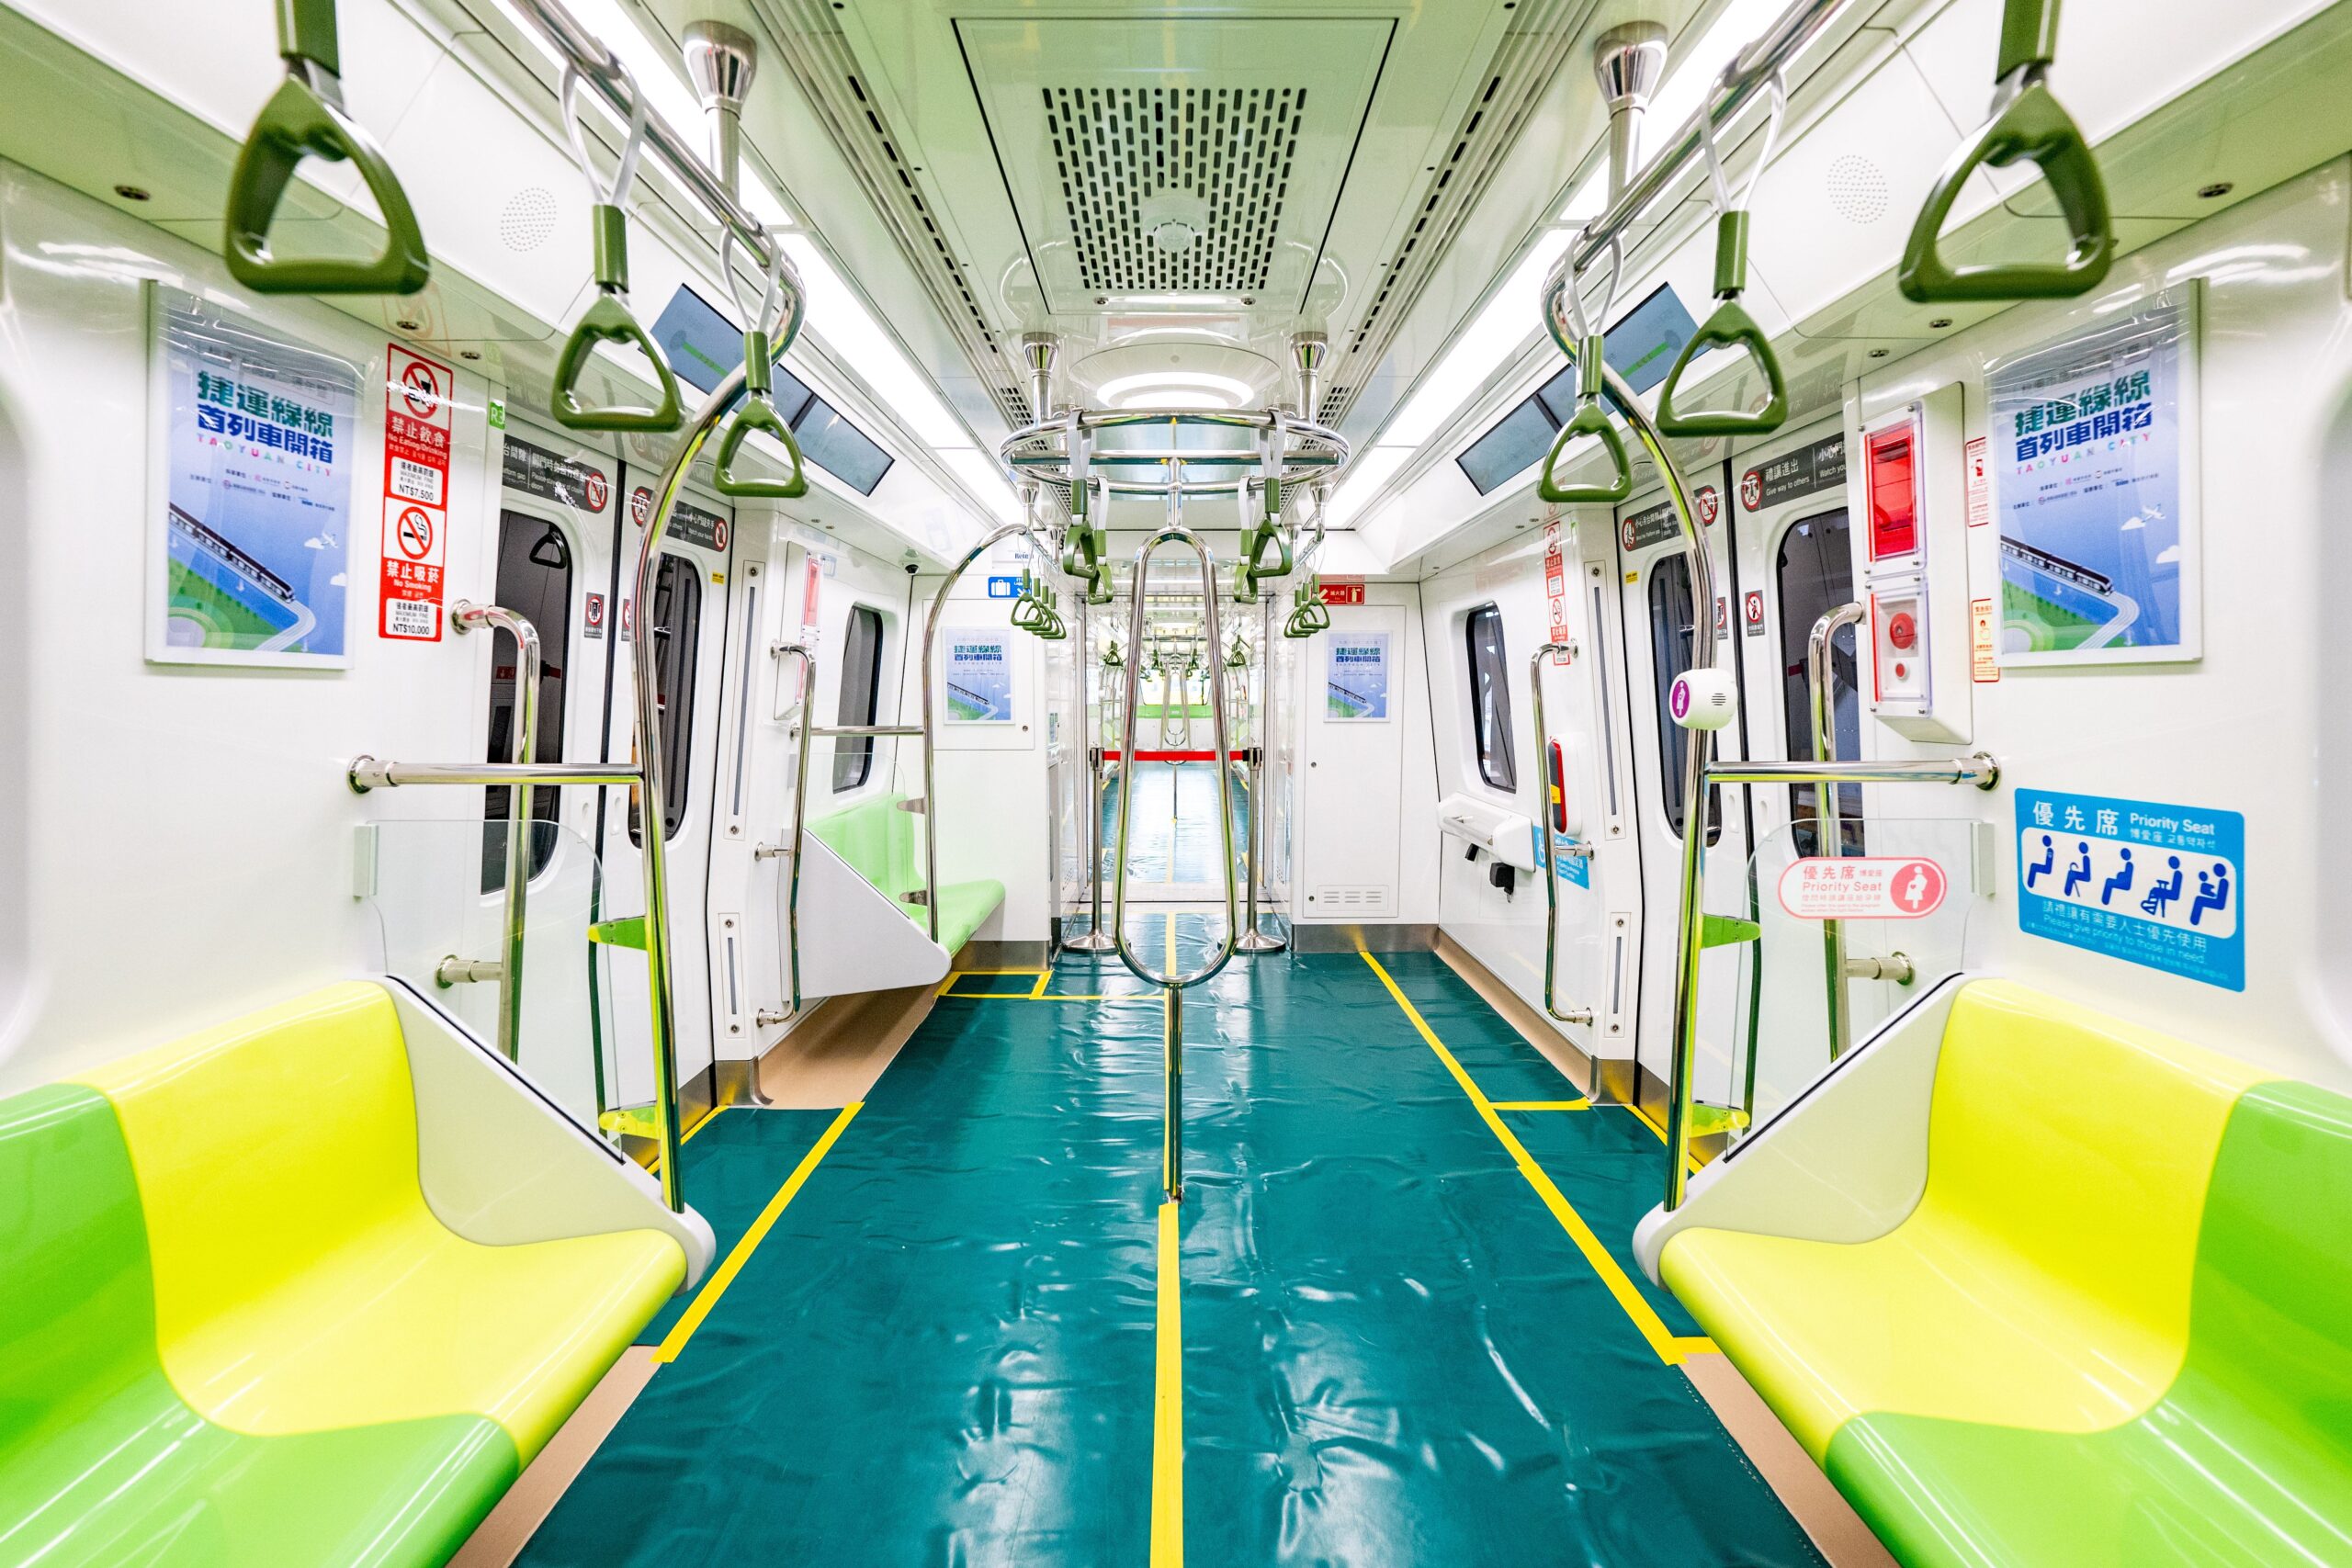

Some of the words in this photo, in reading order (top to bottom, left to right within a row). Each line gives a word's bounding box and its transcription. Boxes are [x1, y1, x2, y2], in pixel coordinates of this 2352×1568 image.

[198, 370, 333, 438] 捷運綠線
[2015, 369, 2151, 437] 捷運綠線
[198, 403, 333, 464] 首列車開箱
[392, 416, 444, 448] 禁止飲食
[2016, 401, 2152, 462] 首列車開箱
[197, 433, 285, 464] TAOYUAN
[296, 461, 332, 477] CITY
[1818, 441, 1846, 462] 小心門
[2017, 447, 2095, 475] TAOYUAN
[2108, 432, 2152, 451] CITY
[1765, 457, 1799, 482] 禮讓進出
[1820, 467, 1836, 479] Watch
[399, 484, 434, 502] NT$7,500
[1766, 488, 1777, 497] Give
[1778, 484, 1787, 492] way
[1793, 476, 1810, 487] others
[387, 559, 439, 583] 禁止吸菸
[393, 579, 403, 587] No
[405, 581, 432, 592] Smoking
[393, 623, 430, 635] NT$10,000
[2033, 800, 2120, 836] 優先席
[2130, 812, 2178, 833] Priority
[2183, 818, 2215, 836] Seat
[2130, 828, 2163, 844] 博愛座
[1803, 865, 1856, 879] 優先席
[1803, 882, 1849, 893] Priority
[1853, 882, 1882, 891] Seat
[2042, 901, 2207, 953] 請禮讓有需要人士優先使用
[2043, 914, 2071, 930] Please
[2073, 923, 2093, 934] give
[2093, 928, 2124, 946] priority
[2125, 934, 2135, 945] to
[2136, 938, 2163, 954] those
[2166, 944, 2177, 957] in
